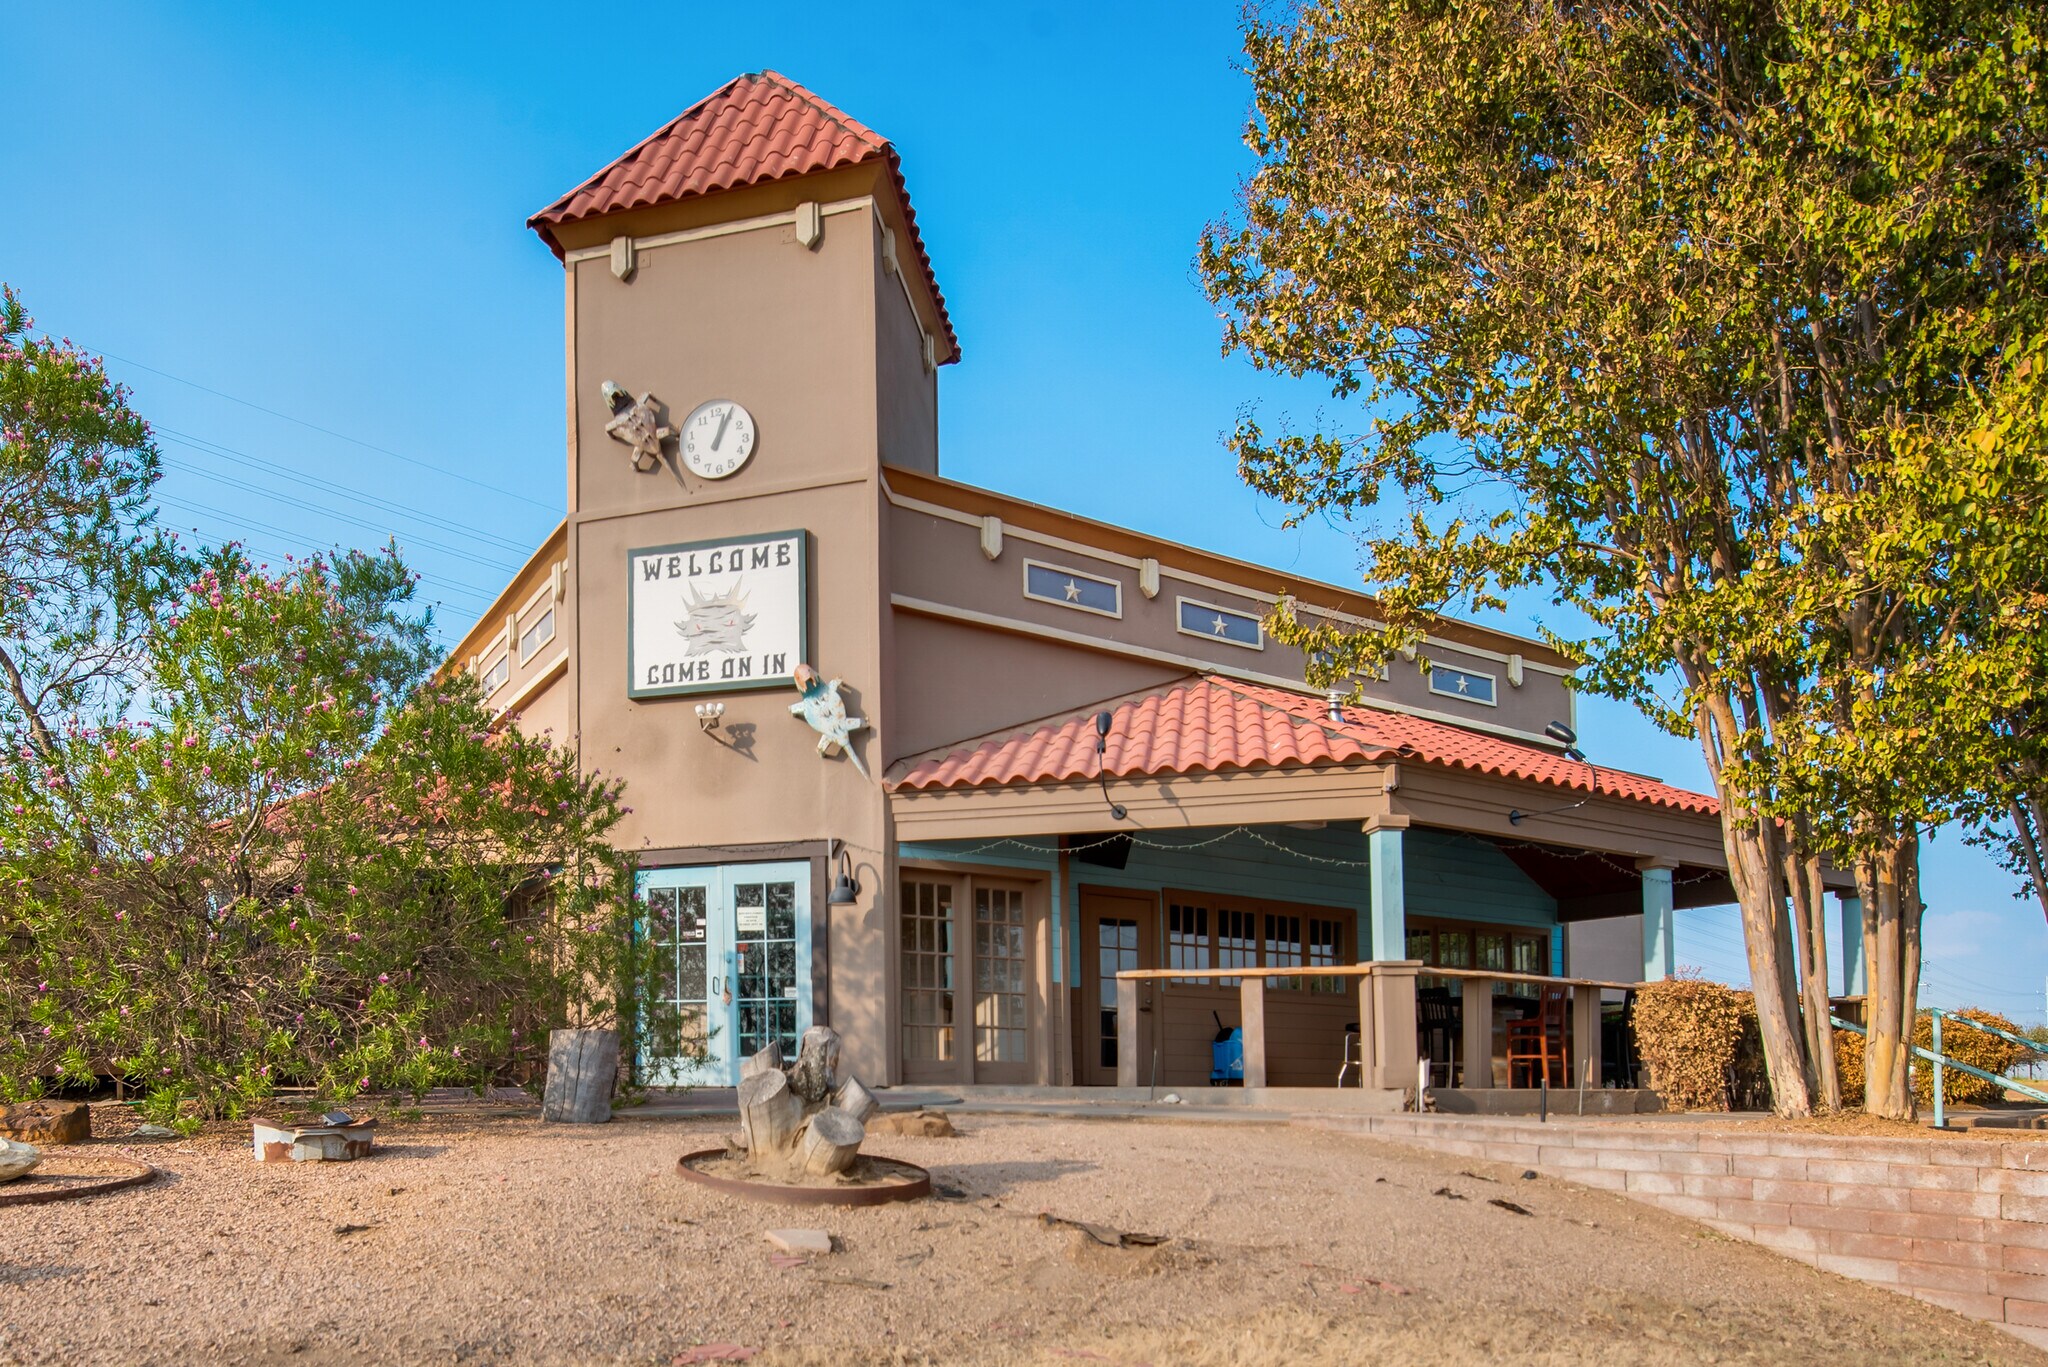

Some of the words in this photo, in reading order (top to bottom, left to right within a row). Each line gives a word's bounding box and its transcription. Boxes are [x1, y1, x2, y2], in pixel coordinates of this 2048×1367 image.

[710, 408, 722, 417] 12
[698, 416, 708, 426] 11
[735, 420, 744, 430] 2
[742, 433, 749, 443] 3
[687, 443, 695, 453] 9
[737, 445, 744, 454] 4
[693, 455, 700, 464] 8
[727, 459, 735, 468] 5
[704, 463, 711, 473] 7
[715, 464, 723, 474] 6
[641, 542, 791, 581] WELCOME
[647, 660, 710, 685] COME
[720, 656, 752, 679] ON
[762, 652, 786, 675] IN
